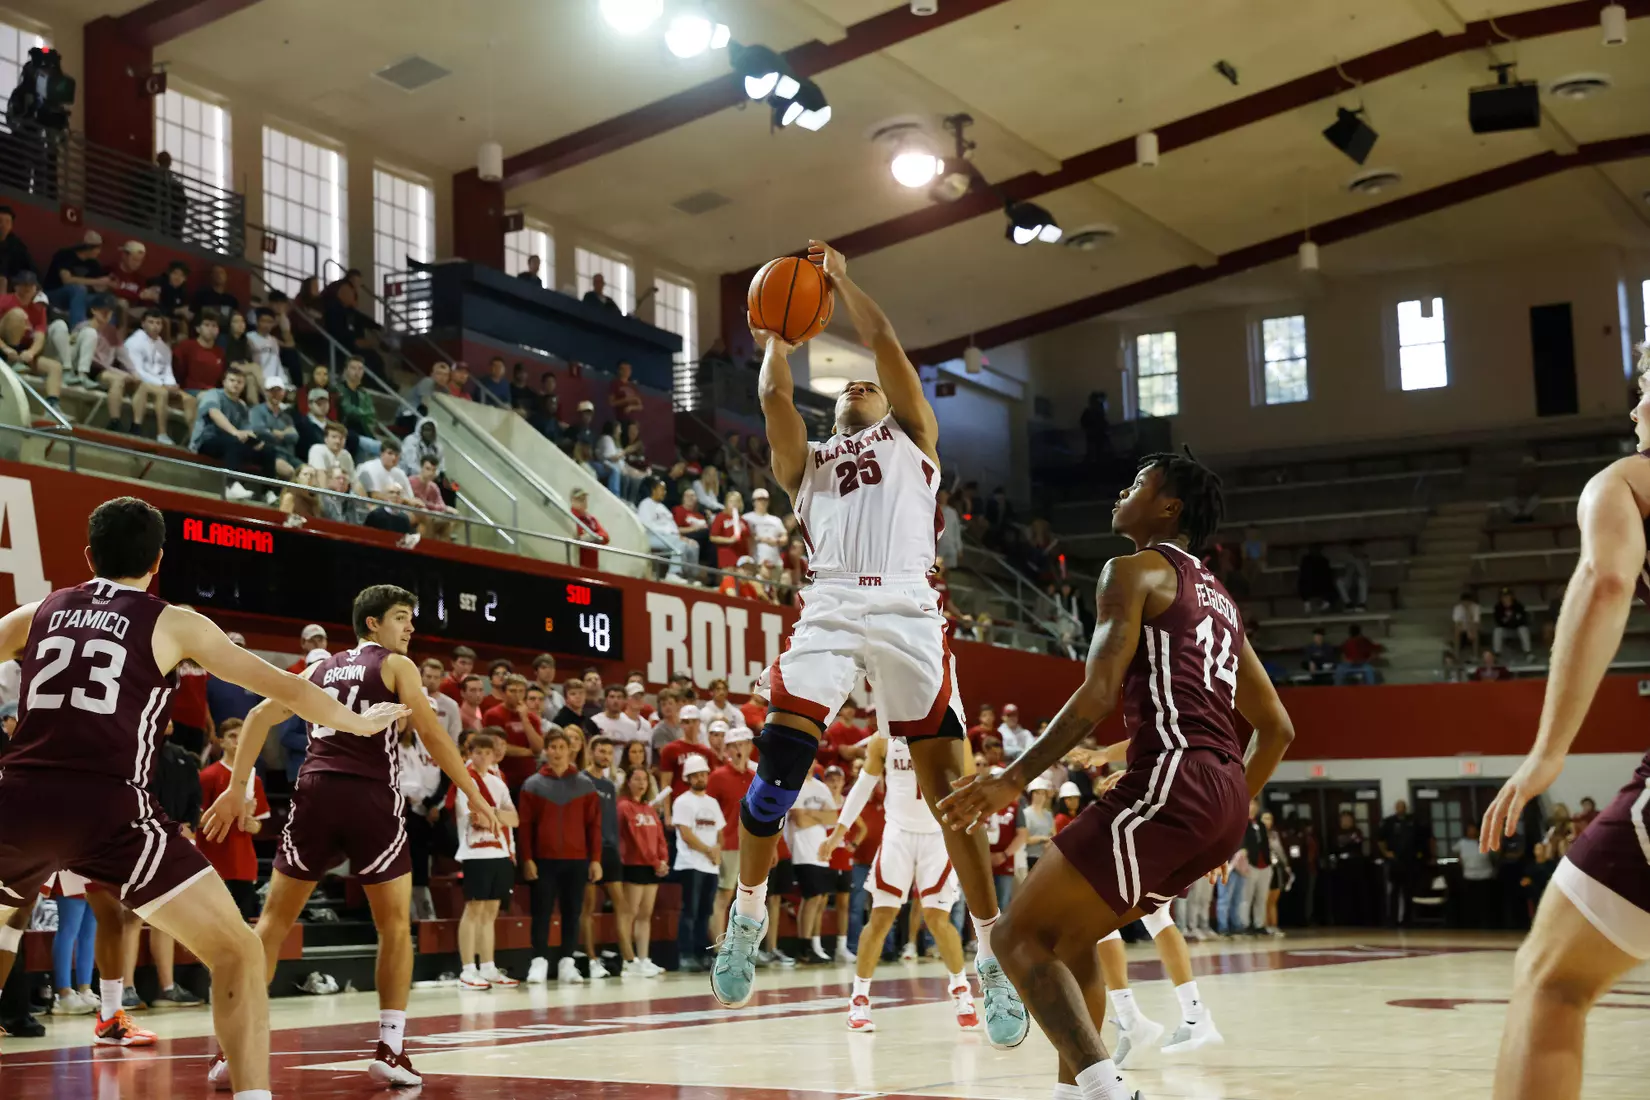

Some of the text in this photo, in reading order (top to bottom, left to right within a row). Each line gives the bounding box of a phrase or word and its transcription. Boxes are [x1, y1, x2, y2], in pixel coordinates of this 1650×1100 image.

[66, 208, 77, 222] G
[814, 425, 894, 469] ALABAMA
[835, 450, 883, 497] 25
[183, 518, 274, 553] ALABAMA
[566, 584, 591, 605] SIU
[858, 576, 882, 587] RTR
[485, 590, 498, 622] 2
[47, 609, 130, 640] D'AMICO
[579, 612, 610, 652] 48
[27, 635, 127, 715] 23
[323, 664, 366, 686] BROWN
[1195, 614, 1238, 709] 14
